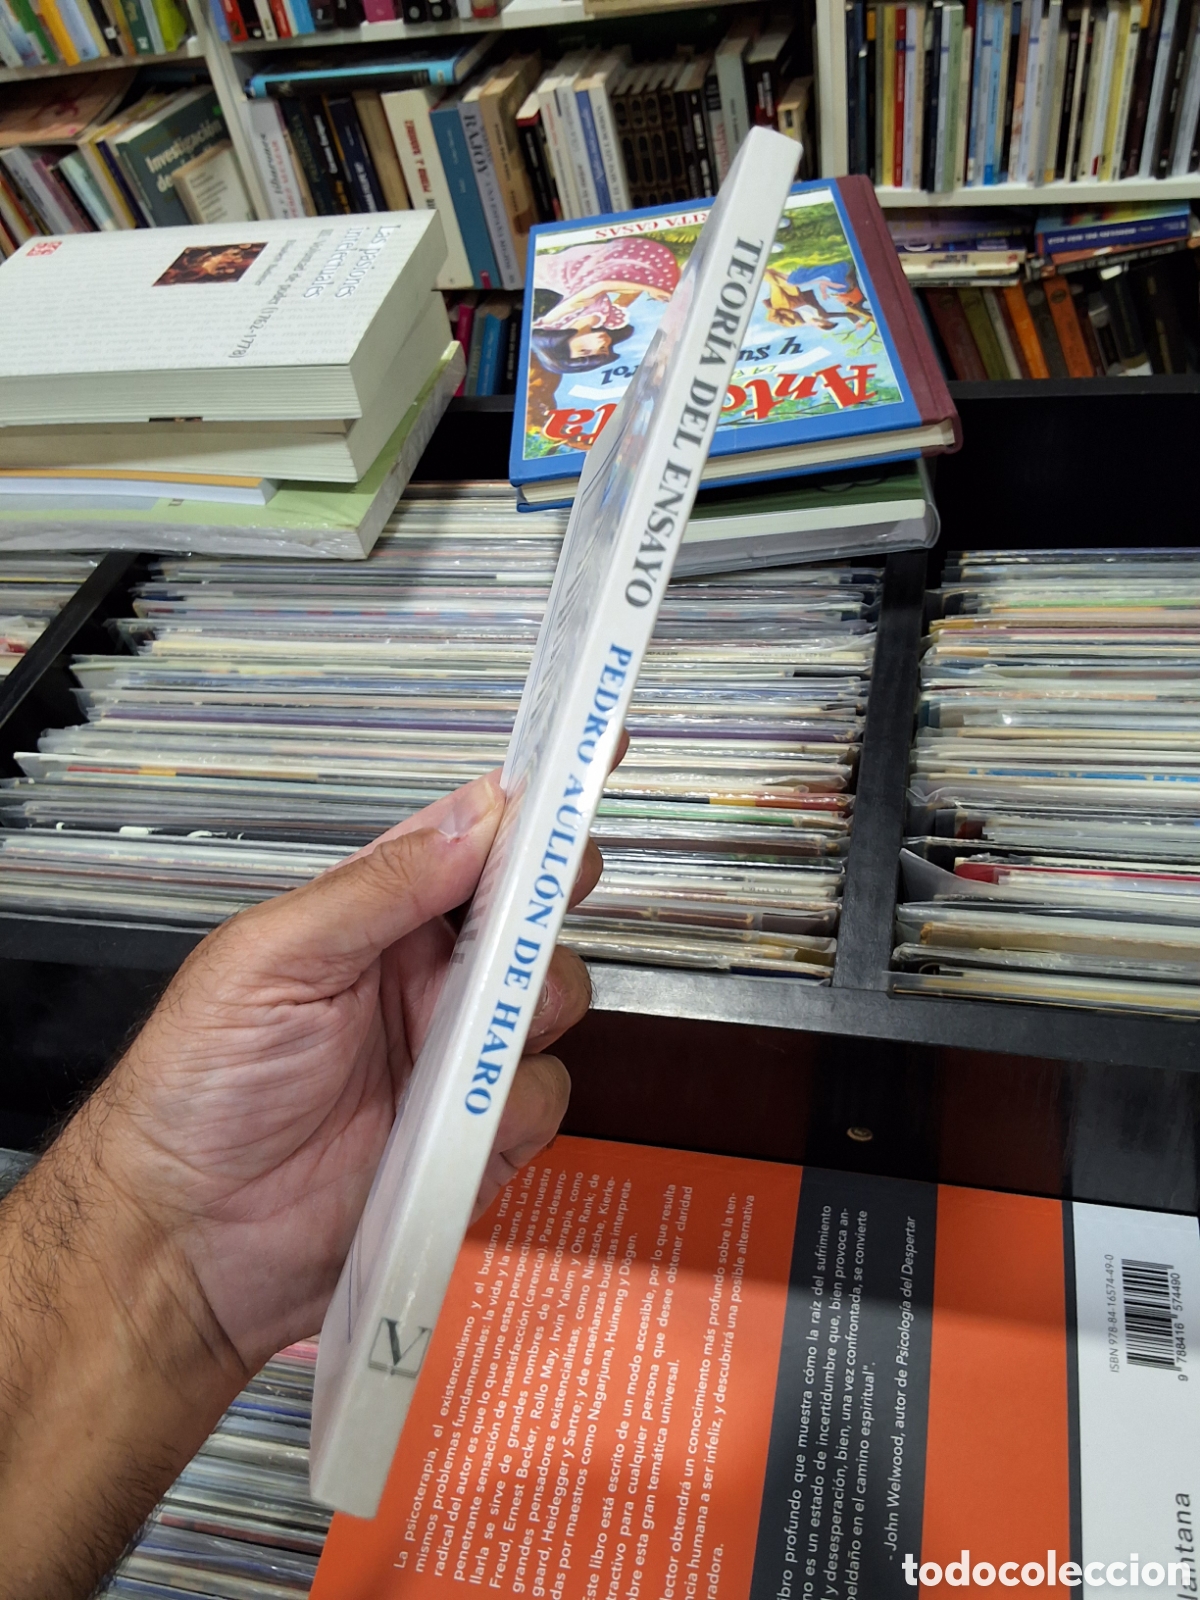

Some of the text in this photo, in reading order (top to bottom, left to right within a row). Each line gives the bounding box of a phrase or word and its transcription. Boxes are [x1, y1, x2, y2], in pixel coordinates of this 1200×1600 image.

[145, 116, 223, 173] Investigación
[463, 114, 489, 174] RAJOY
[371, 224, 401, 244] Las
[595, 221, 658, 239] CASAS
[303, 227, 370, 298] intelectuales
[335, 247, 381, 298] pasiones
[700, 236, 764, 366] TEORÍA
[228, 307, 278, 358] (1762-1778)
[778, 336, 804, 355] y
[673, 376, 719, 450] DEL
[625, 460, 692, 608] ENSAYO
[464, 644, 633, 1116] PEDRO AULLÓN DE HARO
[496, 1186, 513, 1217] tratan
[516, 1193, 528, 1204] La
[521, 1167, 536, 1189] idea
[477, 1225, 502, 1275] budismo
[505, 1210, 523, 1252] muerte.
[618, 1234, 638, 1276] Dōgen.
[474, 1283, 485, 1294] el
[497, 1256, 510, 1266] la
[482, 1311, 495, 1321] la
[489, 1281, 503, 1306] vida
[604, 1290, 628, 1342] Huineng
[1104, 1254, 1120, 1373] ISBN 978-84-16574-49-0
[1170, 1272, 1183, 1311] 574490
[440, 1317, 475, 1416] existencialismo
[620, 1187, 693, 1536] para cualquier persona que desee obtener claridad
[1174, 1322, 1187, 1364] 788416
[452, 1326, 491, 1427] fundamentales:
[454, 1171, 567, 1581] penetrante sensación de insatisfacción (carencia). Para desarro-
[469, 1173, 584, 1584] llarla se sirve de grandes nombres de la psicoterapia, como
[512, 1177, 615, 1593] grandes pensadores existencialistas, como Nietzsche, Kierke-
[587, 1348, 615, 1420] Nagarjuna,
[669, 1194, 736, 1552] obtendrá un conocimiento más profundo sobre la ten-
[686, 1196, 755, 1568] humana a ser infeliz, y descubrirá una posible alternativa
[784, 1206, 831, 1563] profundo que muestra cómo la raíz del sufrimiento
[806, 1209, 849, 1576] es un estado de incertidumbre que, bien provoca an-
[884, 1217, 918, 1551] John Welwood, autor de Psicología del Despertar
[432, 1425, 444, 1438] el
[823, 1212, 867, 1595] y desesperación, bien, una vez confrontada, se convierte
[433, 1433, 461, 1510] problemas
[581, 1425, 597, 1465] como
[851, 1363, 875, 1535] en el camino espiritual".
[404, 1449, 439, 1541] psicoterapia,
[566, 1470, 588, 1537] maestros
[393, 1552, 408, 1568] La
[416, 1515, 438, 1572] mismos
[559, 1541, 572, 1569] por
[549, 1574, 566, 1600] das
